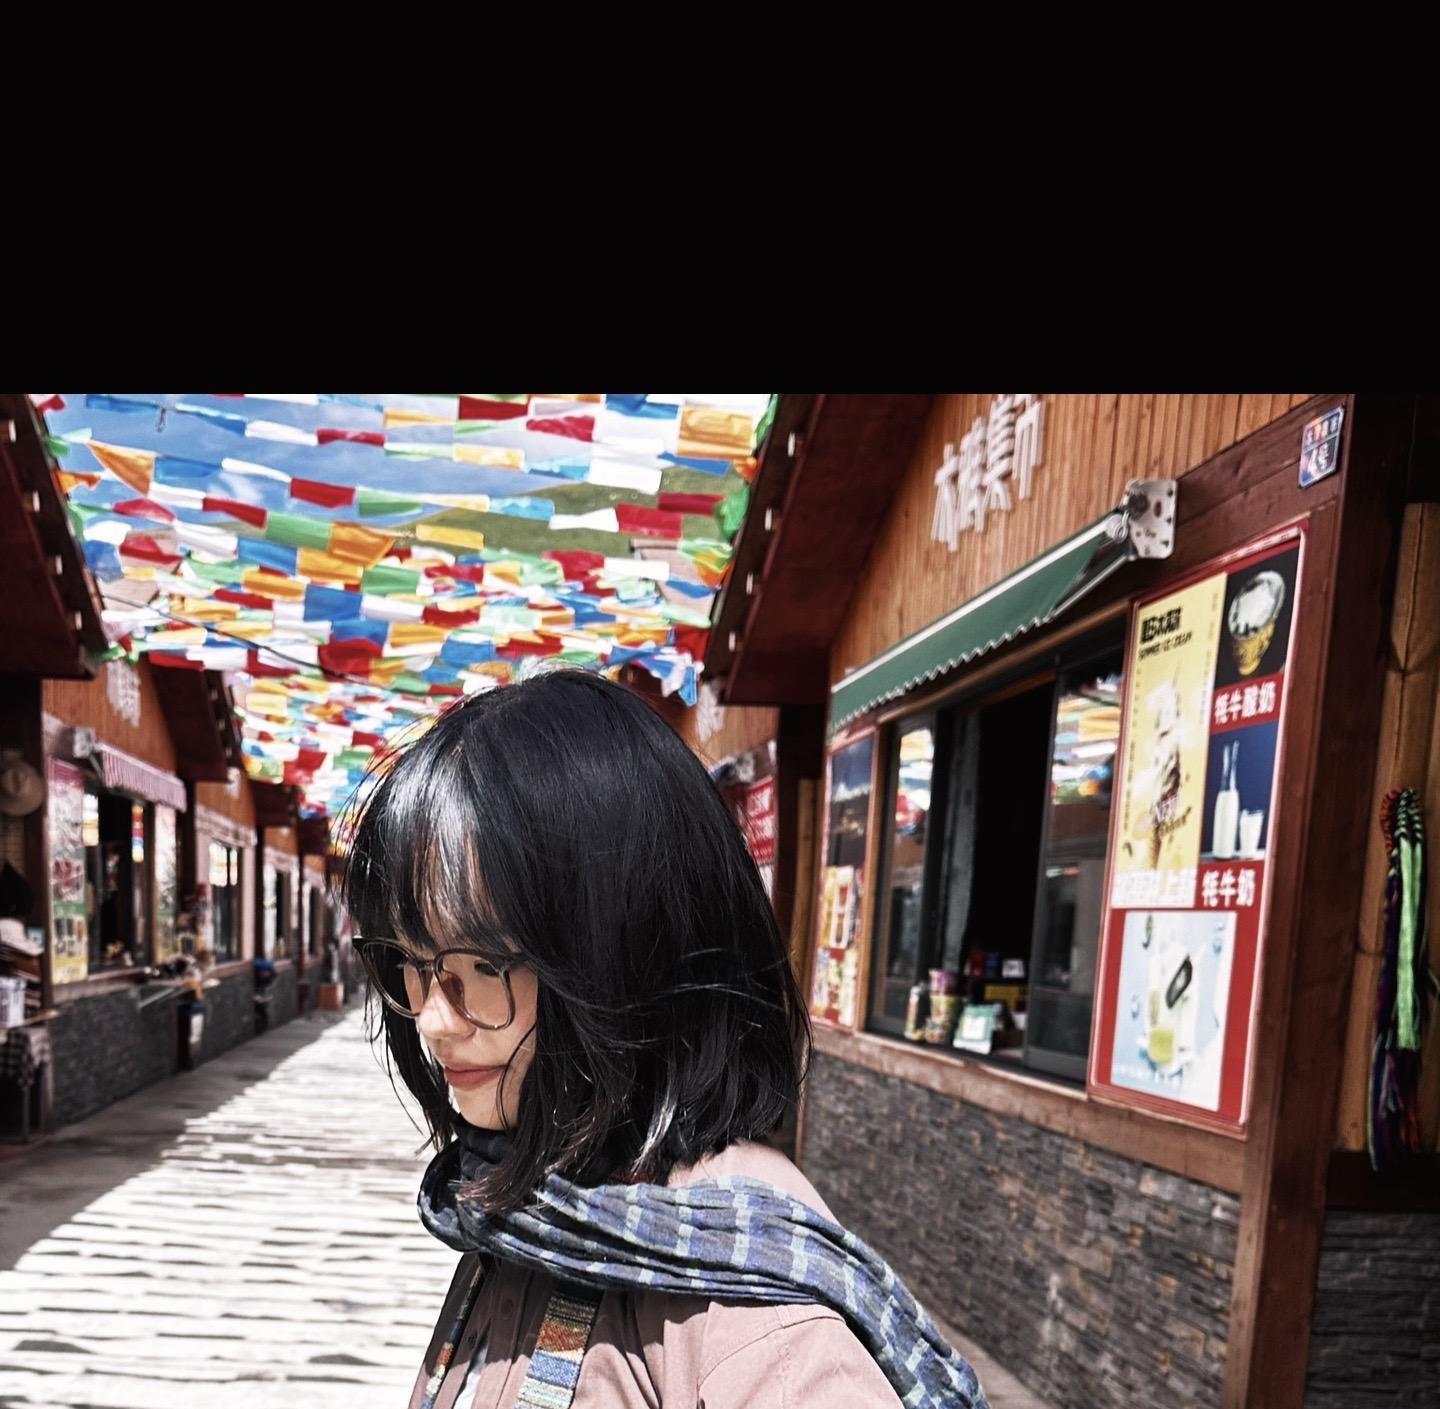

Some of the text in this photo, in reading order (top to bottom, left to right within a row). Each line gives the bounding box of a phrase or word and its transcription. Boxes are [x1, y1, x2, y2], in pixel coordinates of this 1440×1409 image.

[1214, 681, 1276, 725] 牦牛酸奶
[1201, 868, 1256, 907] 牦牛奶
